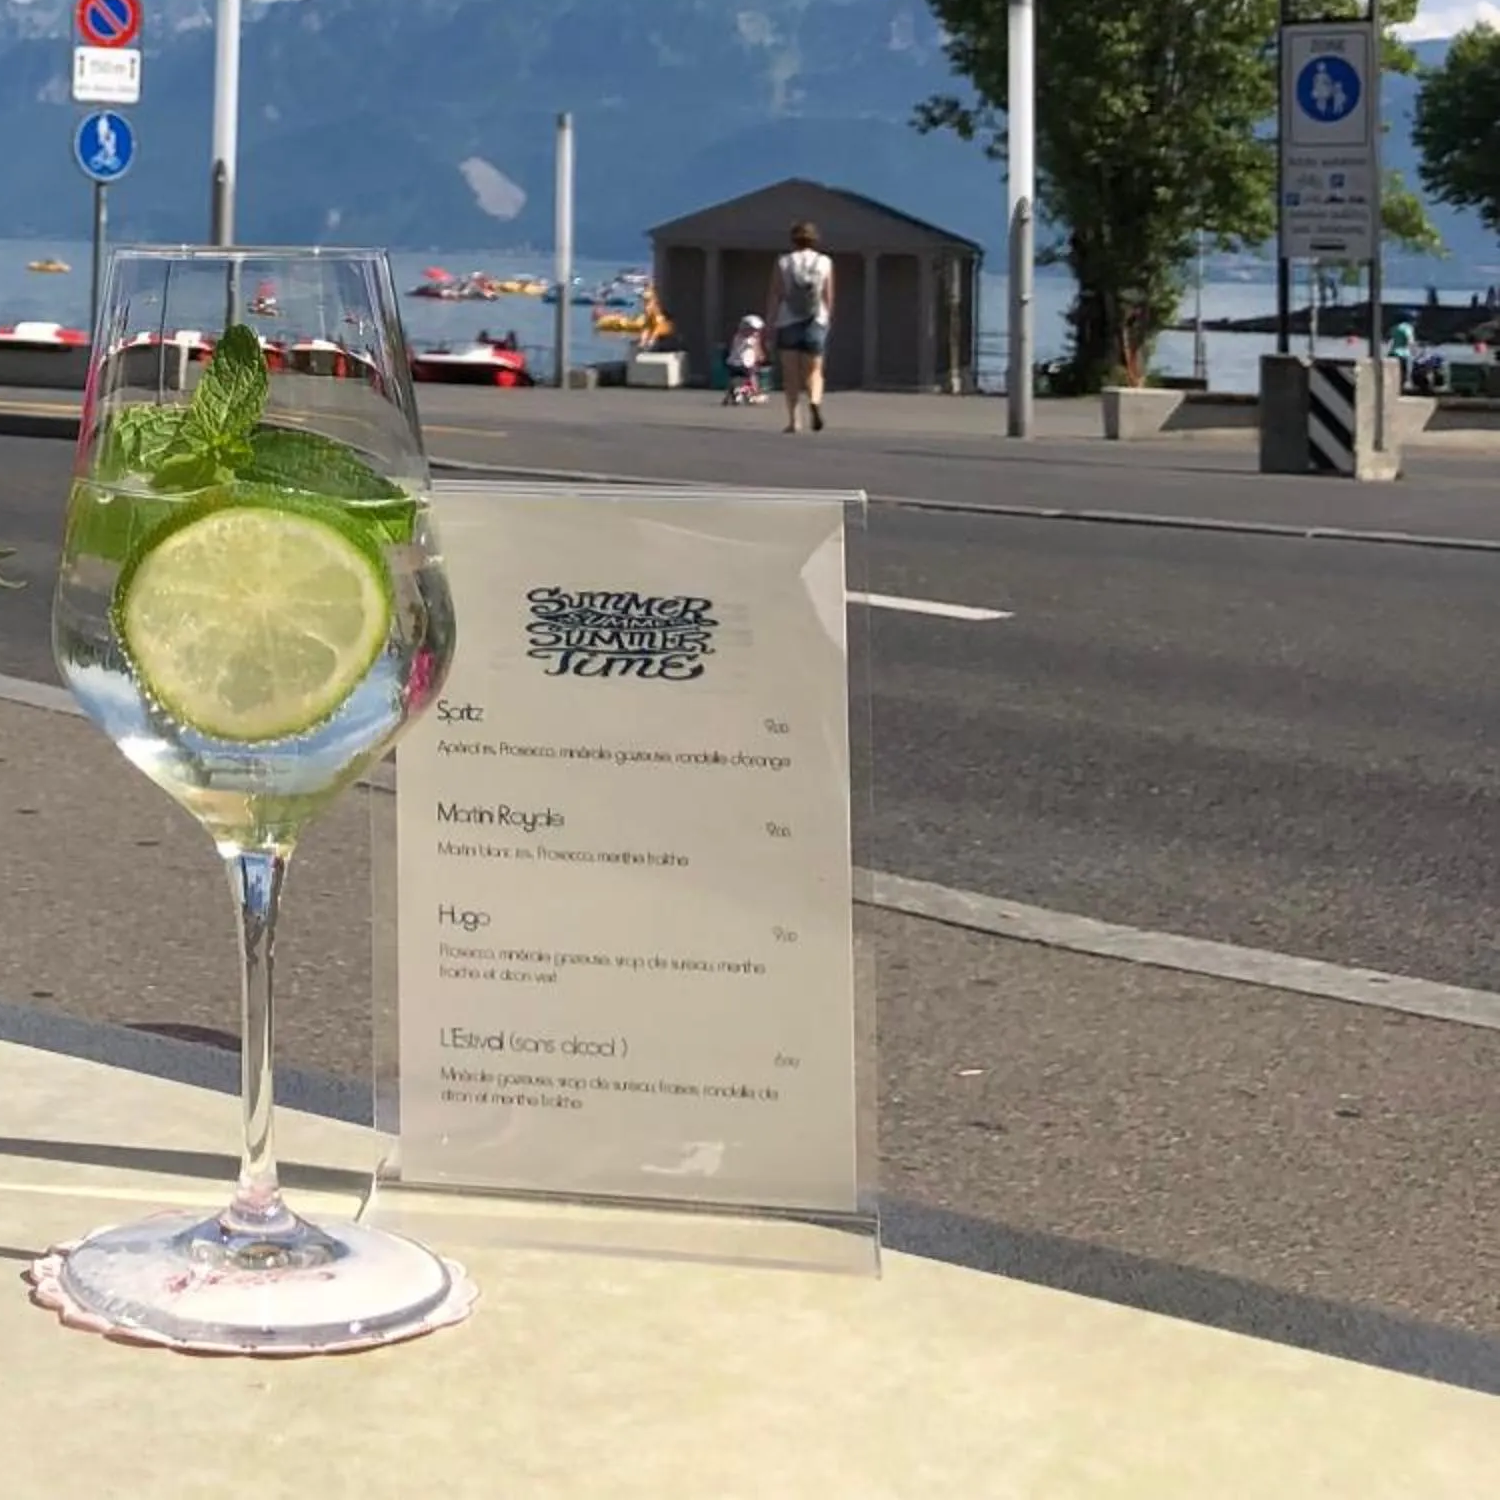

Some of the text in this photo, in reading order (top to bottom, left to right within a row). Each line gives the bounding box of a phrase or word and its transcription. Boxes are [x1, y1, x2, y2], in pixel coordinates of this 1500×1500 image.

[437, 699, 484, 726] Spritz
[437, 802, 495, 825] Martini
[498, 803, 566, 833] Royale
[439, 903, 491, 932] Hugo
